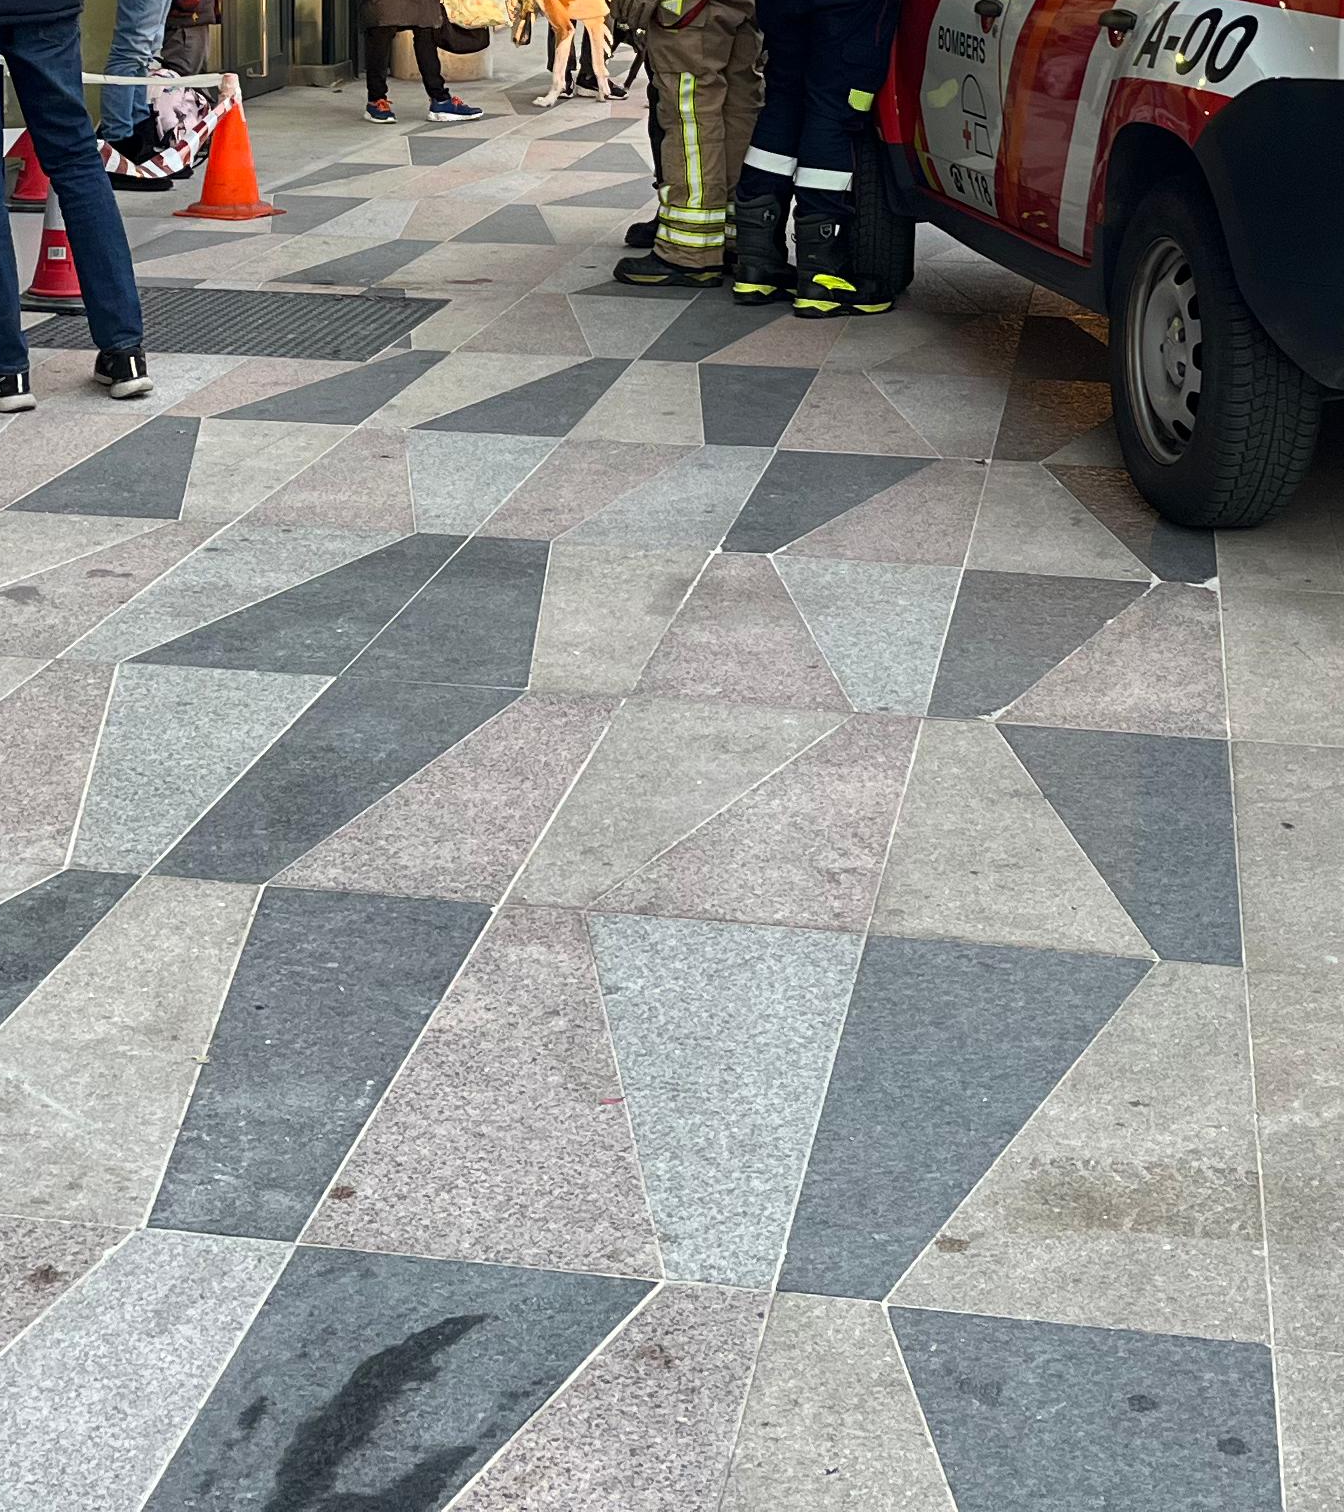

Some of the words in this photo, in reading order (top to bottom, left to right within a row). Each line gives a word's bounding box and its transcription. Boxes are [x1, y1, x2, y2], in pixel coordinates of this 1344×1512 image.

[938, 25, 986, 64] BOMBERS
[1132, 1, 1259, 83] A-00
[967, 166, 993, 207] 118
